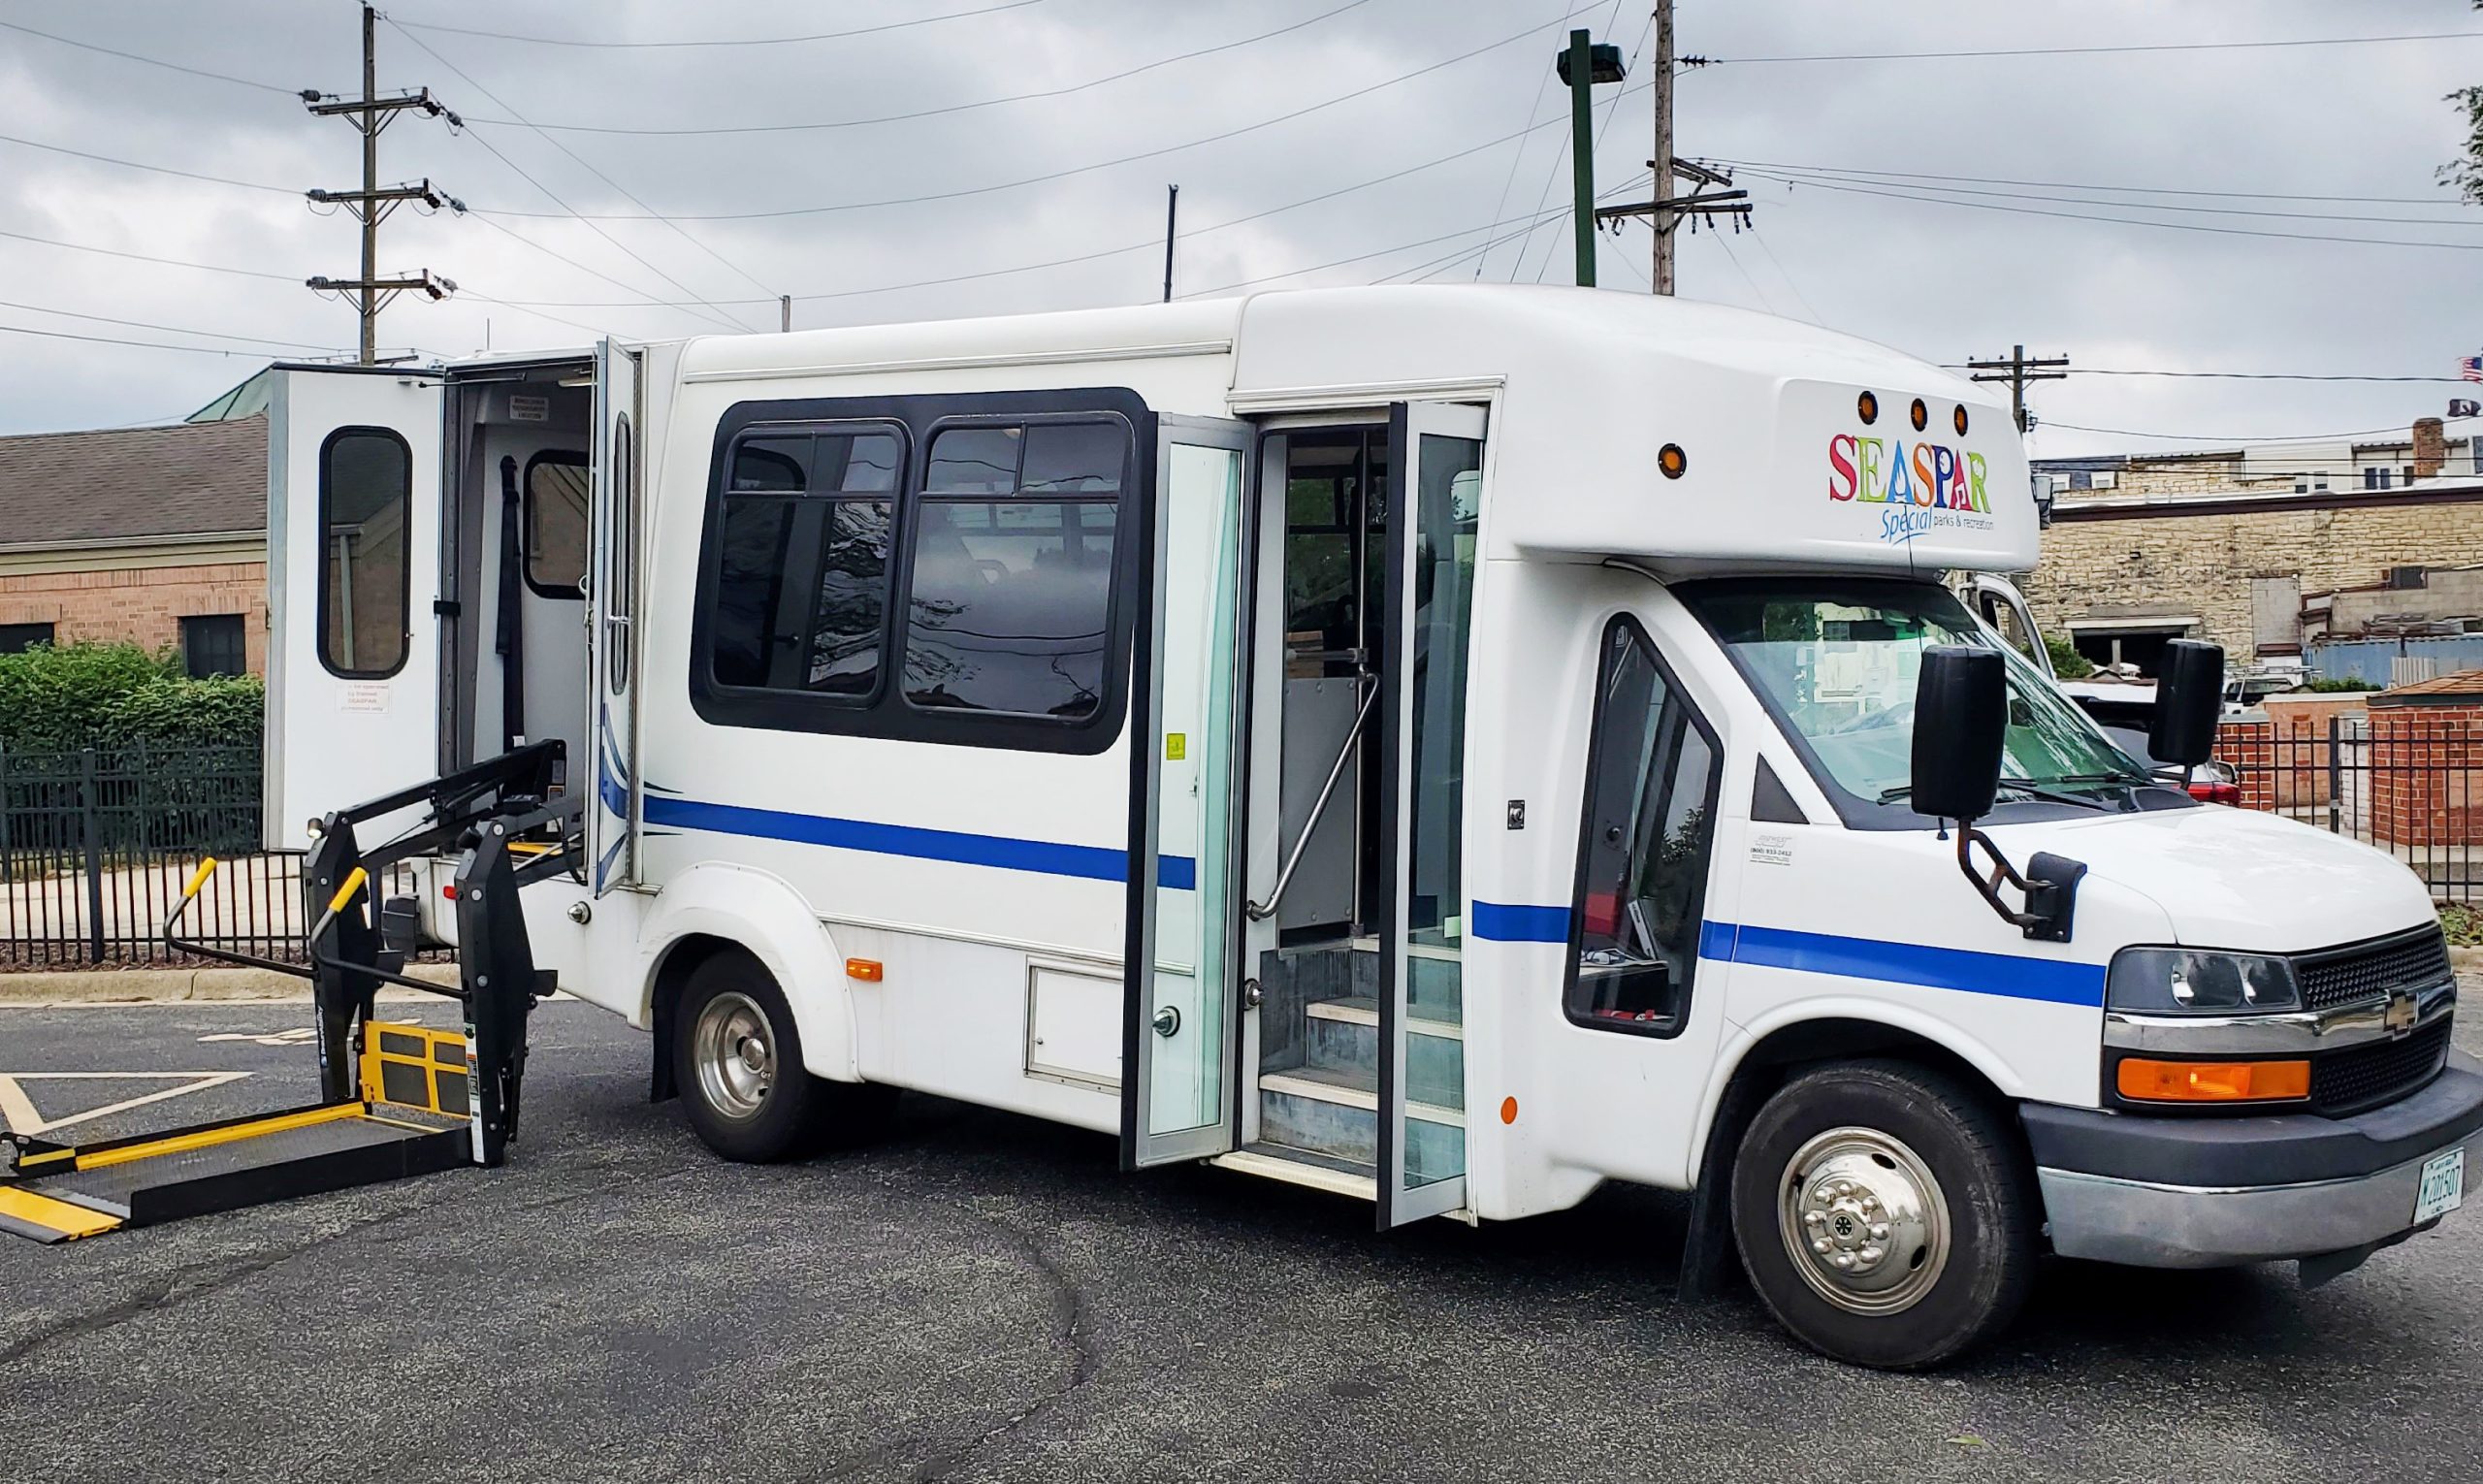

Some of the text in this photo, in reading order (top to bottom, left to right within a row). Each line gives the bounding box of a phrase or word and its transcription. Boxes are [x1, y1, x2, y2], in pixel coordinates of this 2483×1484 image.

[1829, 434, 1991, 514] SEASPAR
[1880, 506, 1933, 543] Special
[1933, 514, 1954, 528] parks
